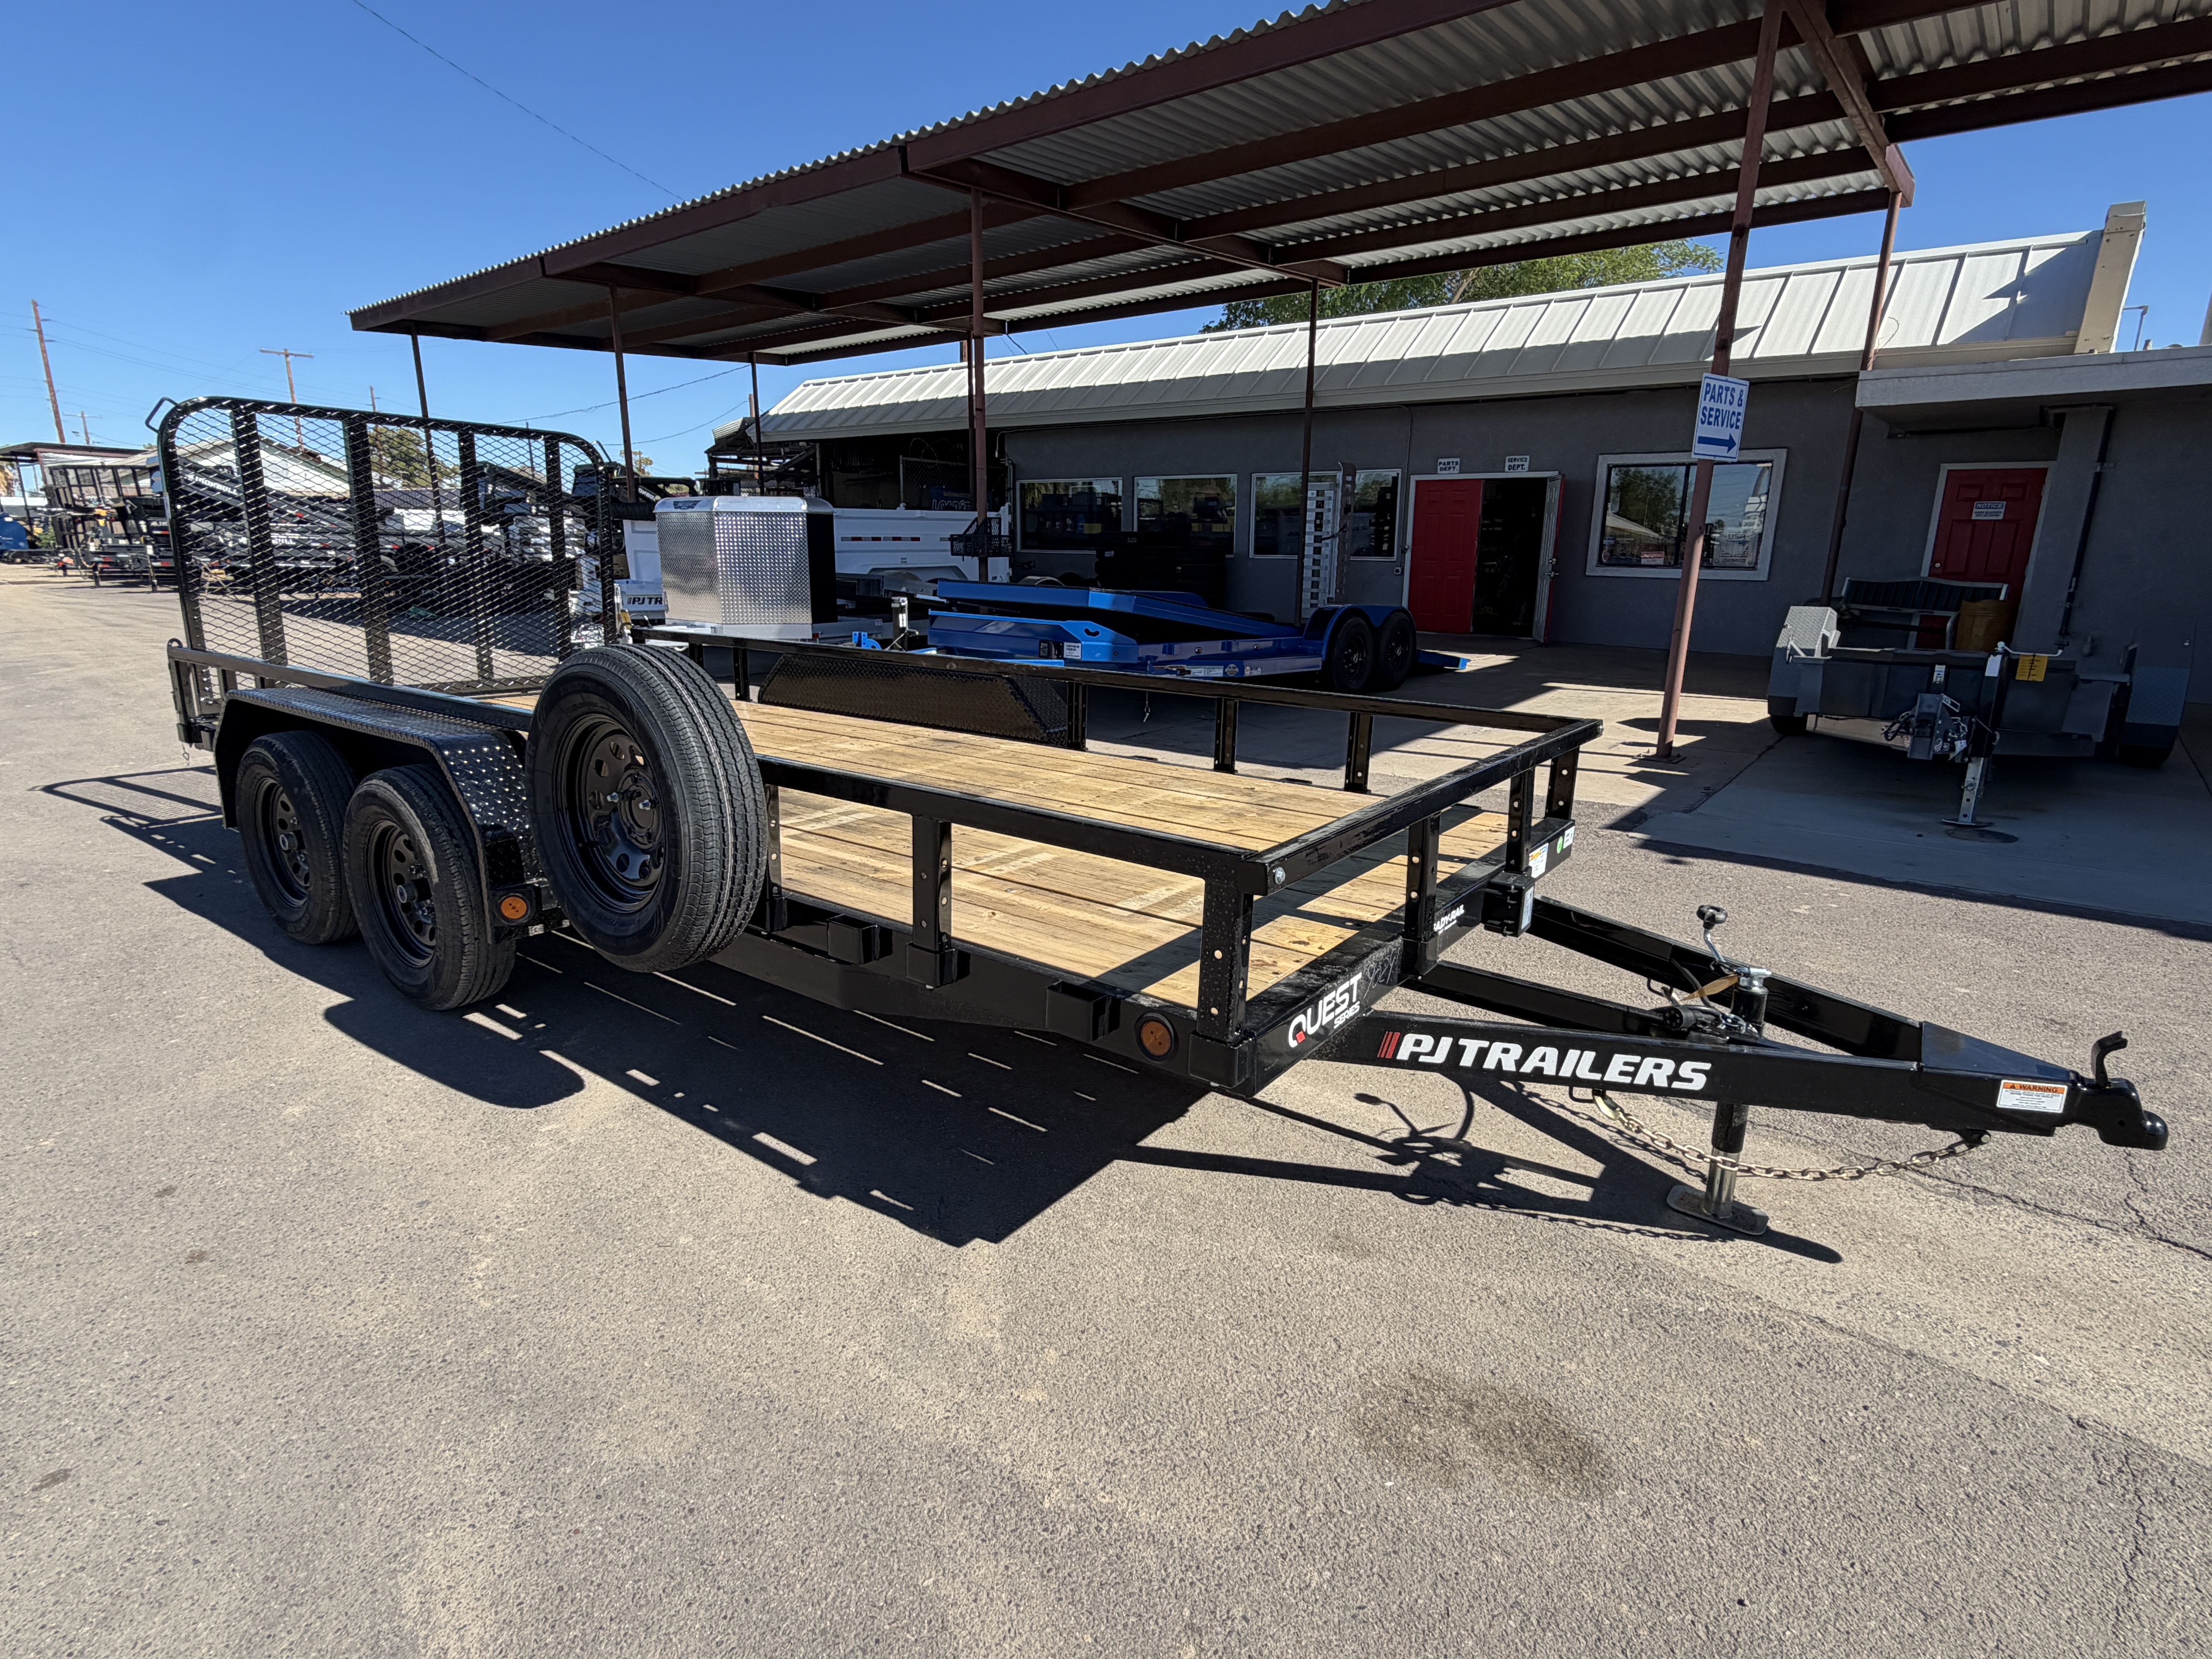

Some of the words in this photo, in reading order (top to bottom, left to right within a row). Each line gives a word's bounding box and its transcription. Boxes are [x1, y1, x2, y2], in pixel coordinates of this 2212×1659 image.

[1704, 383, 1735, 406] PARTS
[1737, 389, 1744, 407] &
[1700, 406, 1741, 429] SERVICE
[1288, 972, 1362, 1048] QUEST
[1334, 1001, 1360, 1029] SERIES
[1396, 1033, 1453, 1064] PJ
[1458, 1038, 1712, 1091] TRAILERS
[2020, 1084, 2058, 1092] WARNING
